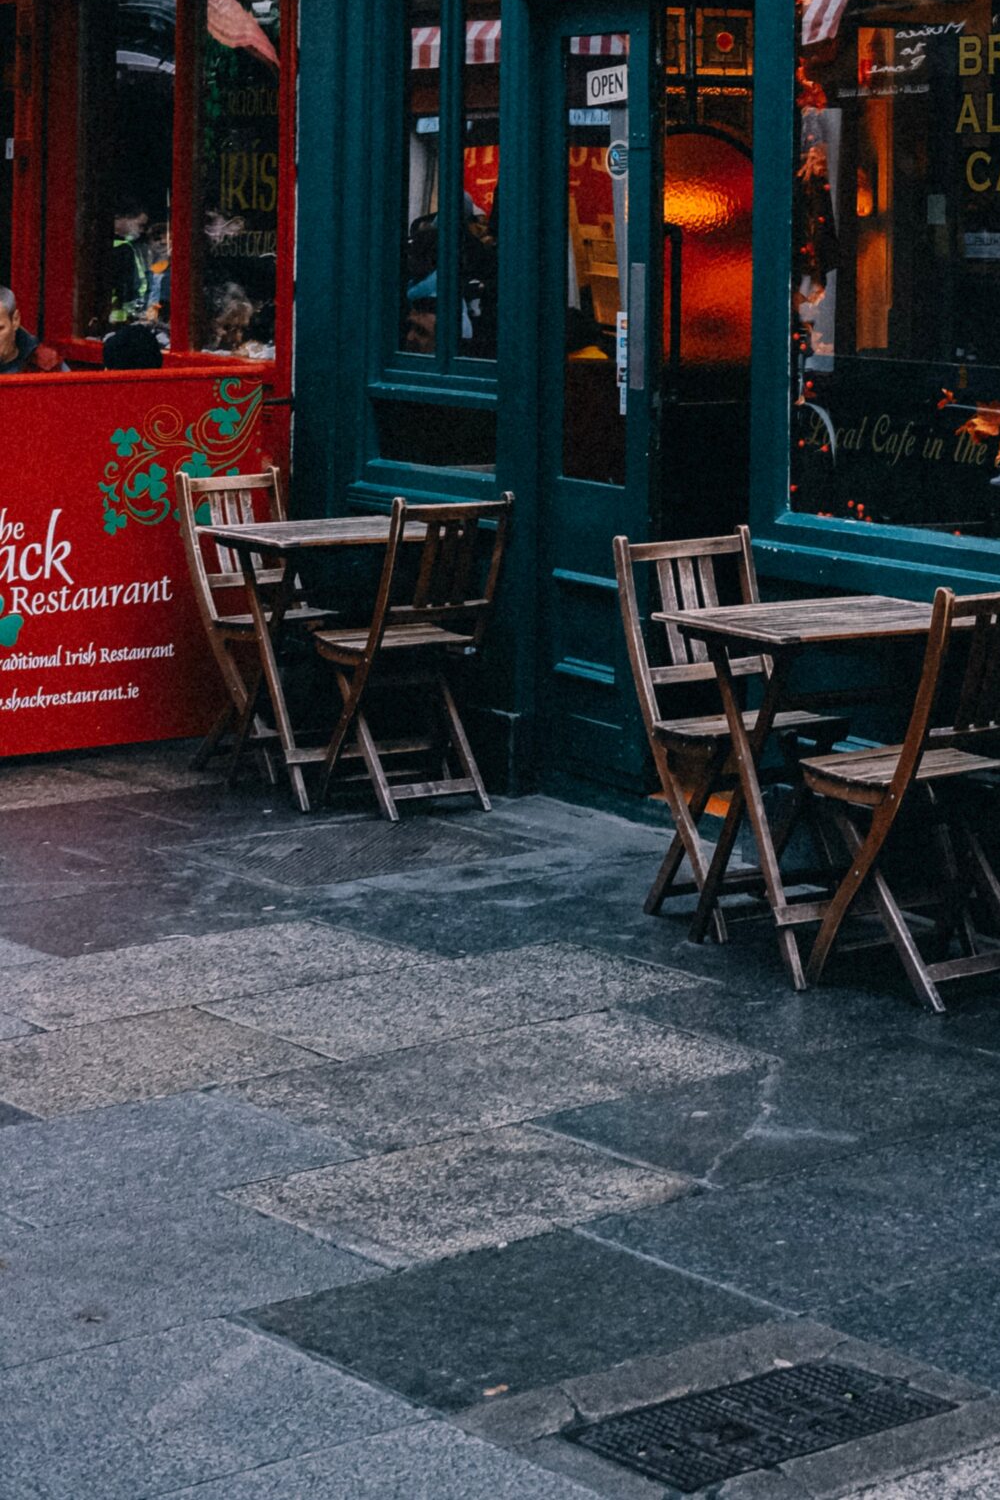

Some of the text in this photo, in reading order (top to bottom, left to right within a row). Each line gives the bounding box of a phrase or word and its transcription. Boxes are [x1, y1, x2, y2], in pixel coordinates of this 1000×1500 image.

[590, 70, 624, 99] OPEN
[872, 413, 915, 467] Cafe
[922, 428, 944, 460] in
[9, 576, 174, 616] Restaurant
[0, 642, 176, 672] aditional Irish Restaurant
